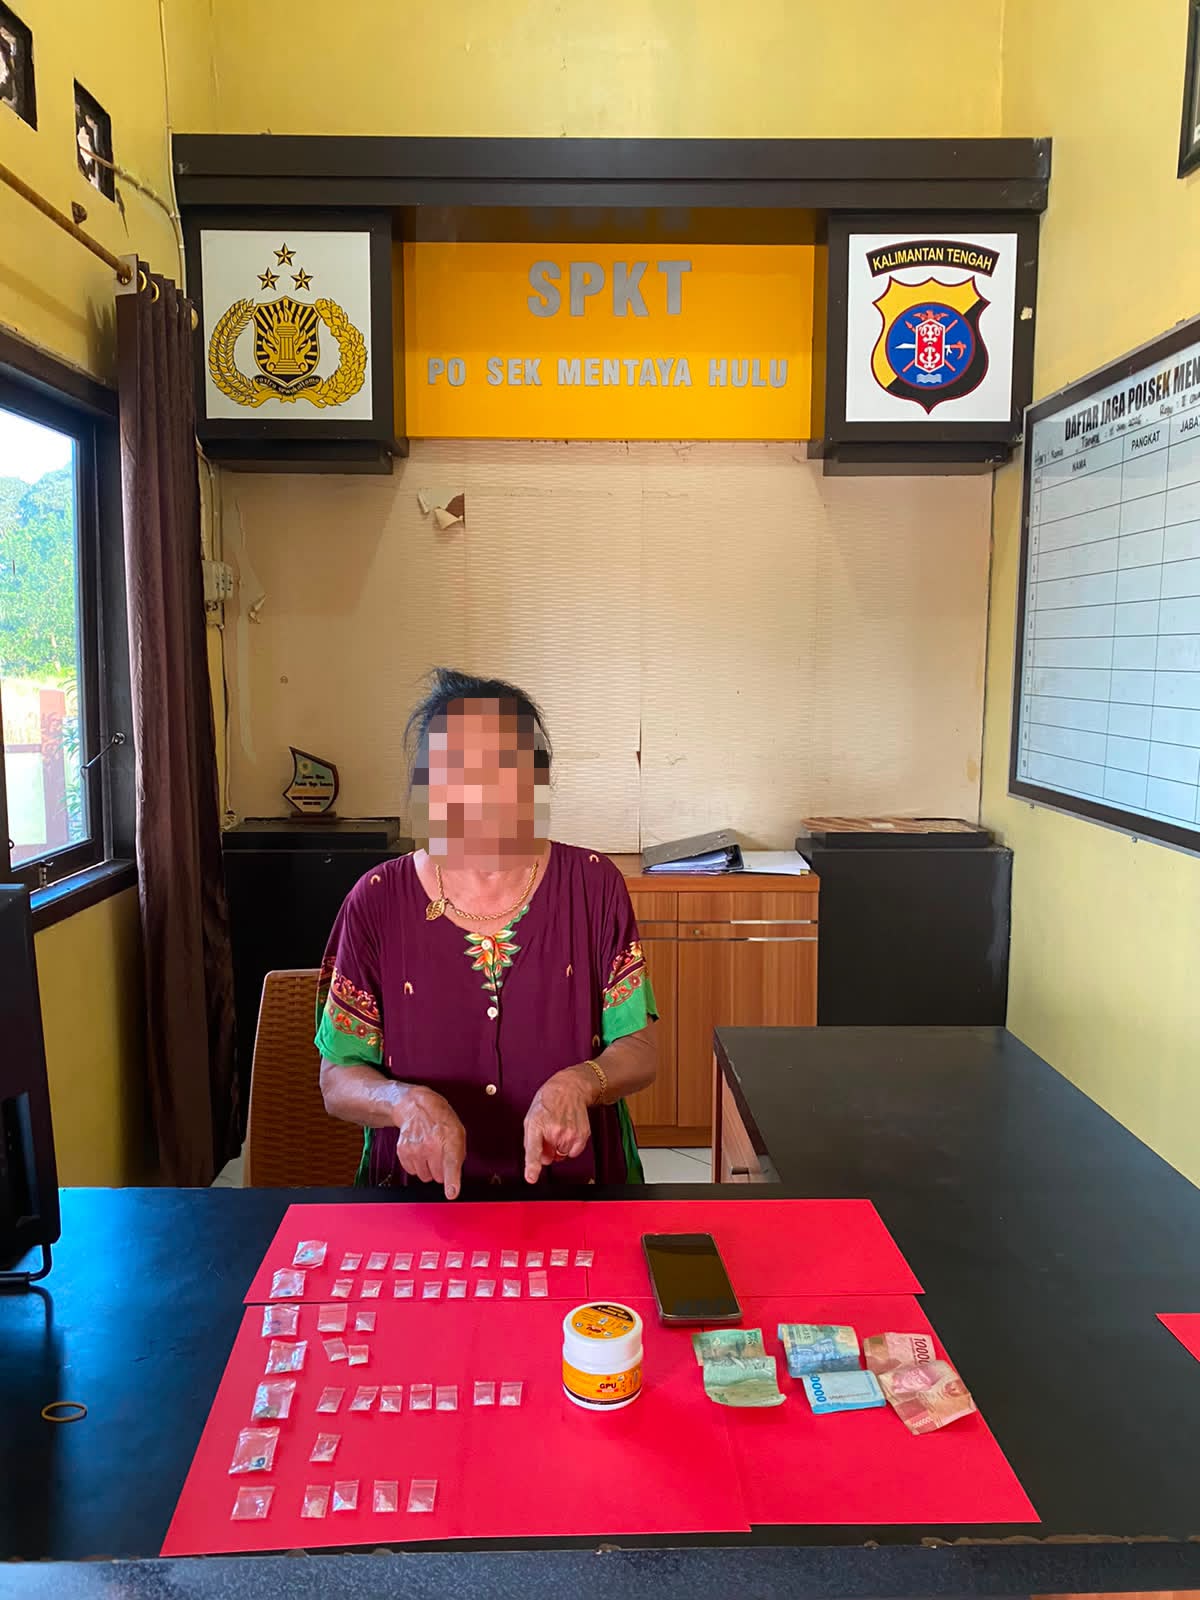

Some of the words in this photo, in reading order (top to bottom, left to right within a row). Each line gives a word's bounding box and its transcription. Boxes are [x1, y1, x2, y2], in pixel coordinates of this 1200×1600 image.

[873, 248, 944, 271] KALIMANTAN
[947, 248, 993, 271] TENGAH
[527, 260, 692, 317] SPKT
[558, 358, 692, 387] MENTAYA
[708, 358, 789, 388] HULU
[1065, 402, 1099, 441] DAFTAR
[1100, 391, 1125, 425] JAGA
[1128, 370, 1171, 414] POLSEK
[1131, 430, 1160, 451] PANGKAT
[1180, 415, 1200, 433] JABA
